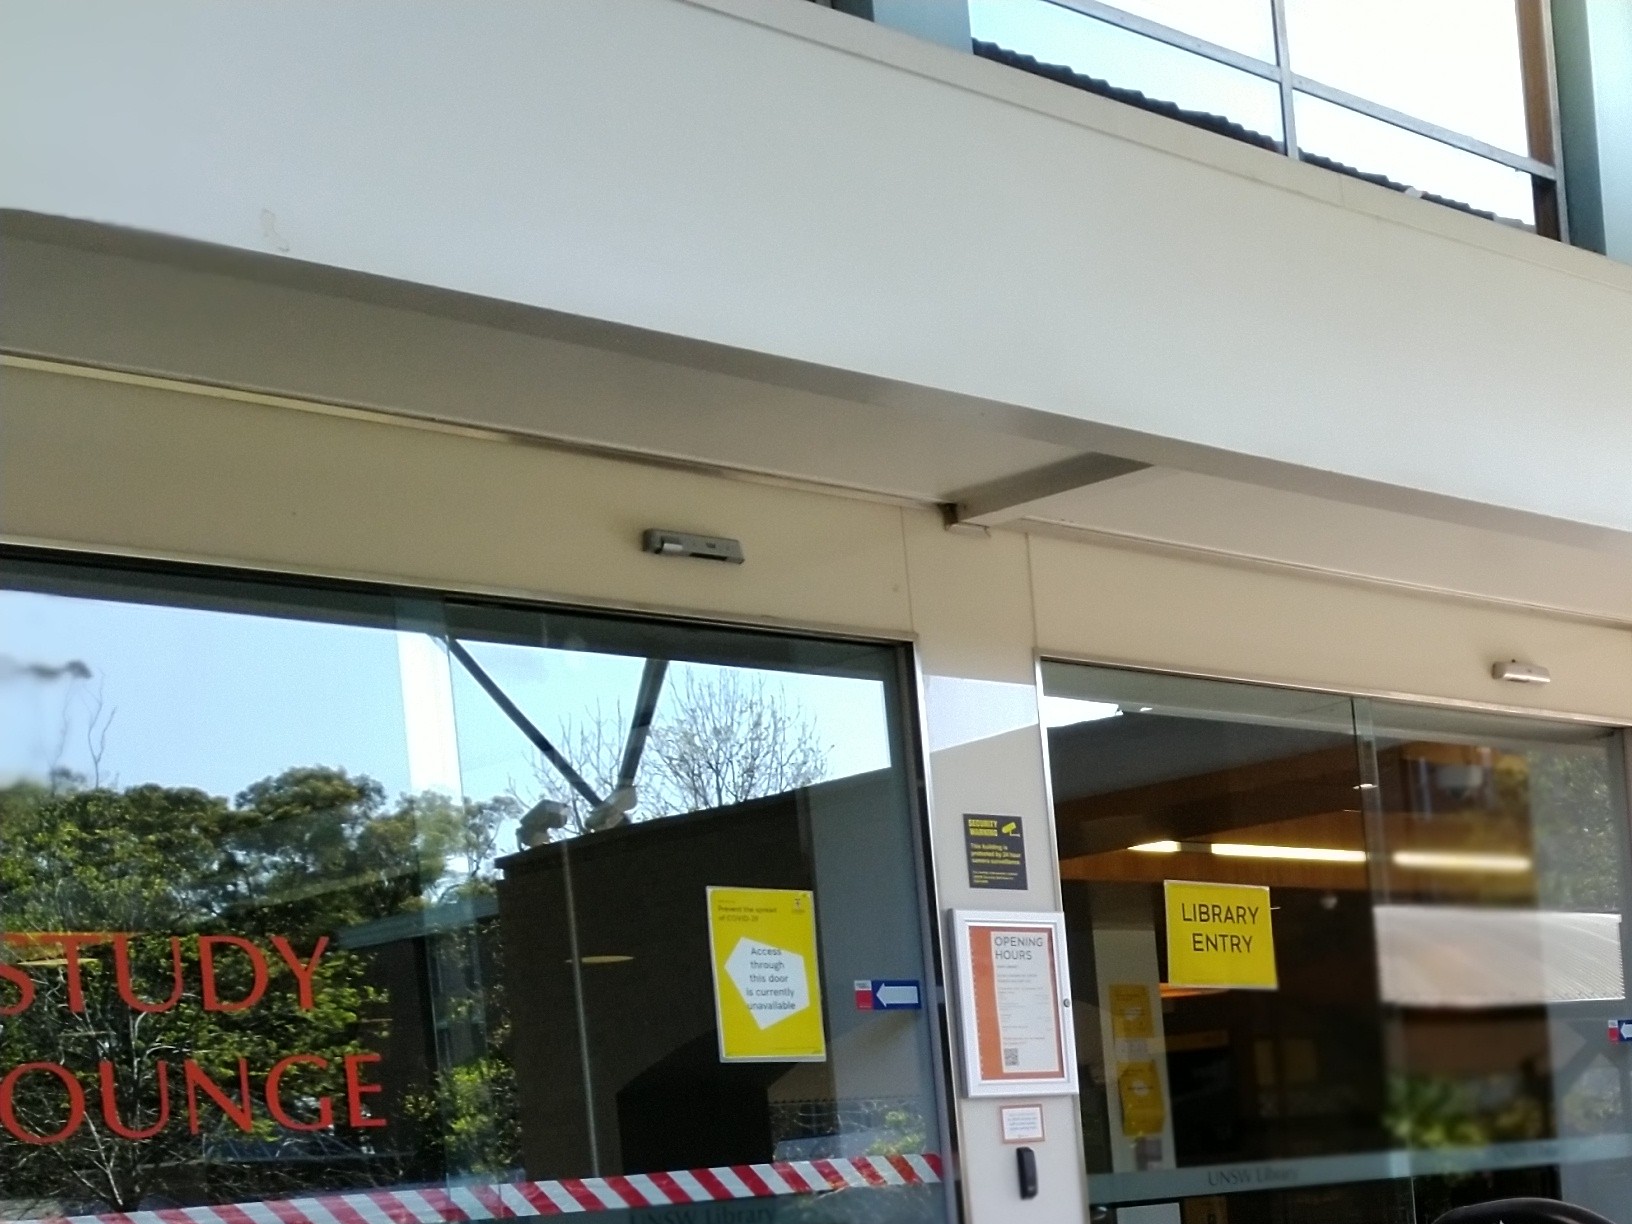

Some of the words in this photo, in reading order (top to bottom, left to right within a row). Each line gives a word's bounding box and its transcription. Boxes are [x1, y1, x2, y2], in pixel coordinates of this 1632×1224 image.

[1181, 902, 1259, 925] LIBRARY
[994, 936, 1044, 948] OPENING
[1192, 932, 1253, 954] ENTRY
[751, 947, 782, 956] Access
[995, 950, 1033, 961] HOURS
[750, 961, 785, 972] through
[0, 932, 330, 1016] STUDY
[750, 973, 767, 983] this
[768, 974, 789, 984] door
[746, 987, 754, 997] is
[755, 987, 795, 998] currently
[748, 1001, 796, 1011] unavailable
